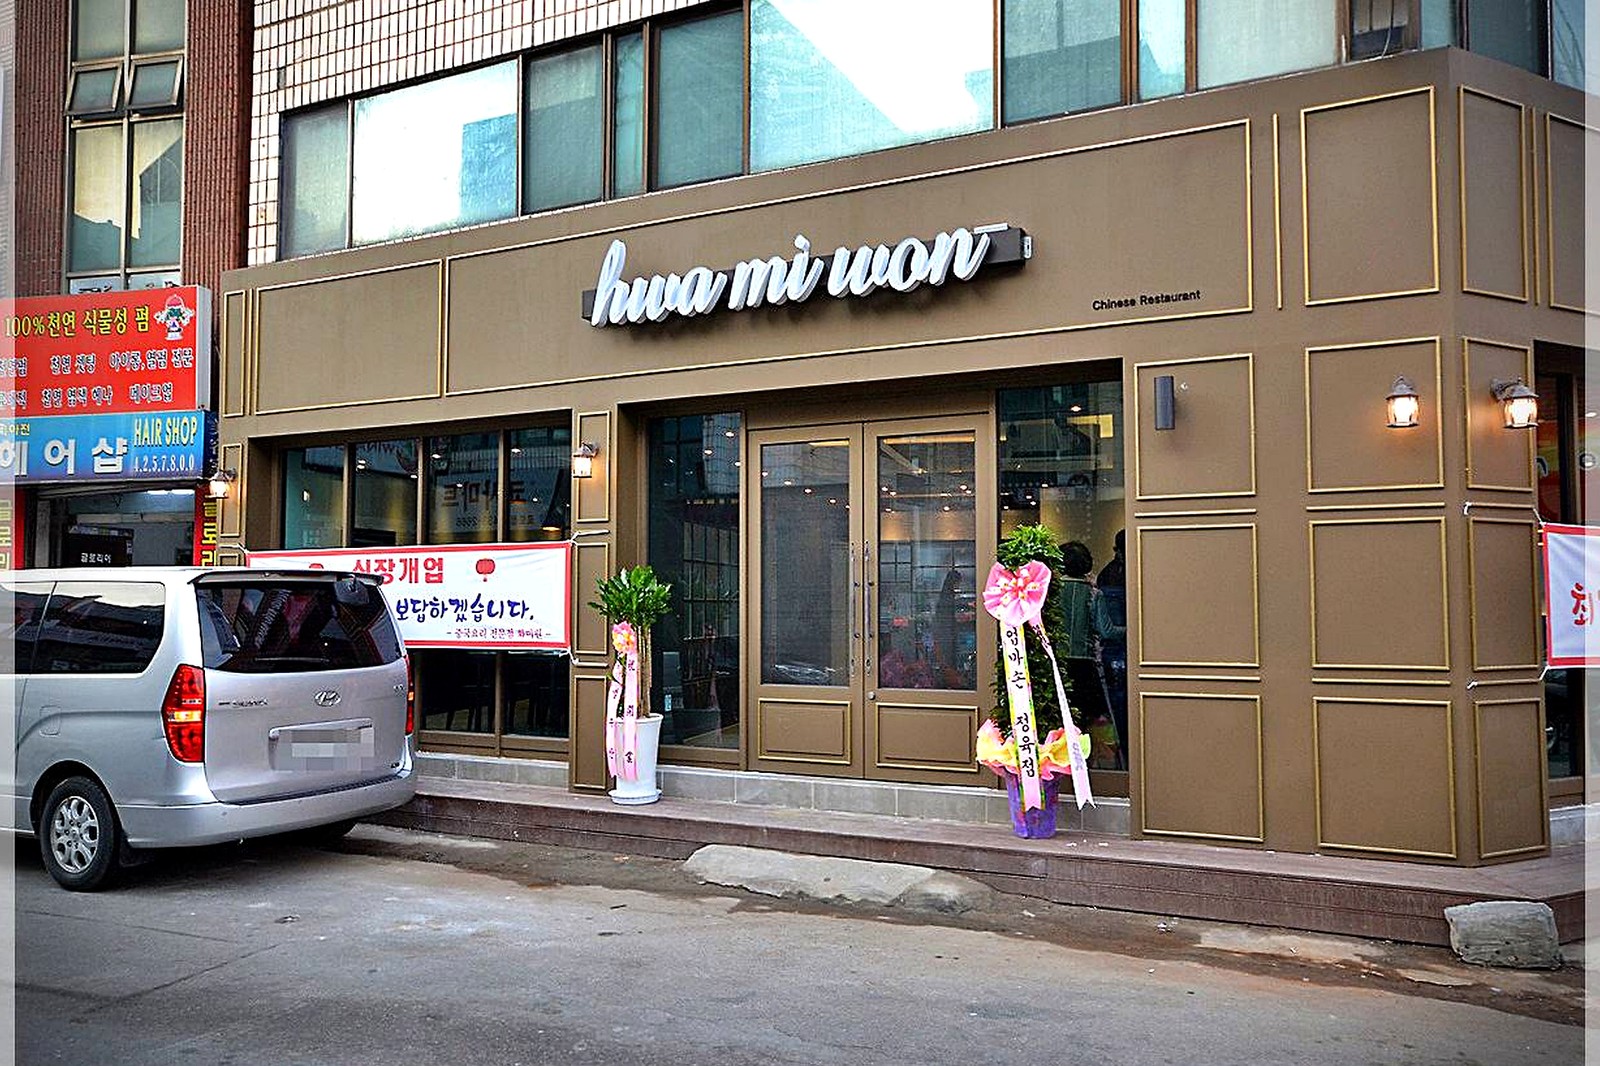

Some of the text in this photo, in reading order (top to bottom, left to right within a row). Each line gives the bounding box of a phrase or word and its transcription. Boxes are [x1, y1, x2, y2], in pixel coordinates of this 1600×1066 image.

[591, 227, 990, 327] hwa mi won
[1092, 290, 1201, 310] Chinese Restaurant
[83, 307, 128, 335] 식물성
[135, 305, 150, 332] 펌
[172, 347, 194, 368] 전문
[134, 418, 163, 446] HAIR
[165, 416, 198, 446] SHOP
[395, 593, 534, 623] 보답하겠습니다.
[1016, 712, 1036, 778] 정육점
